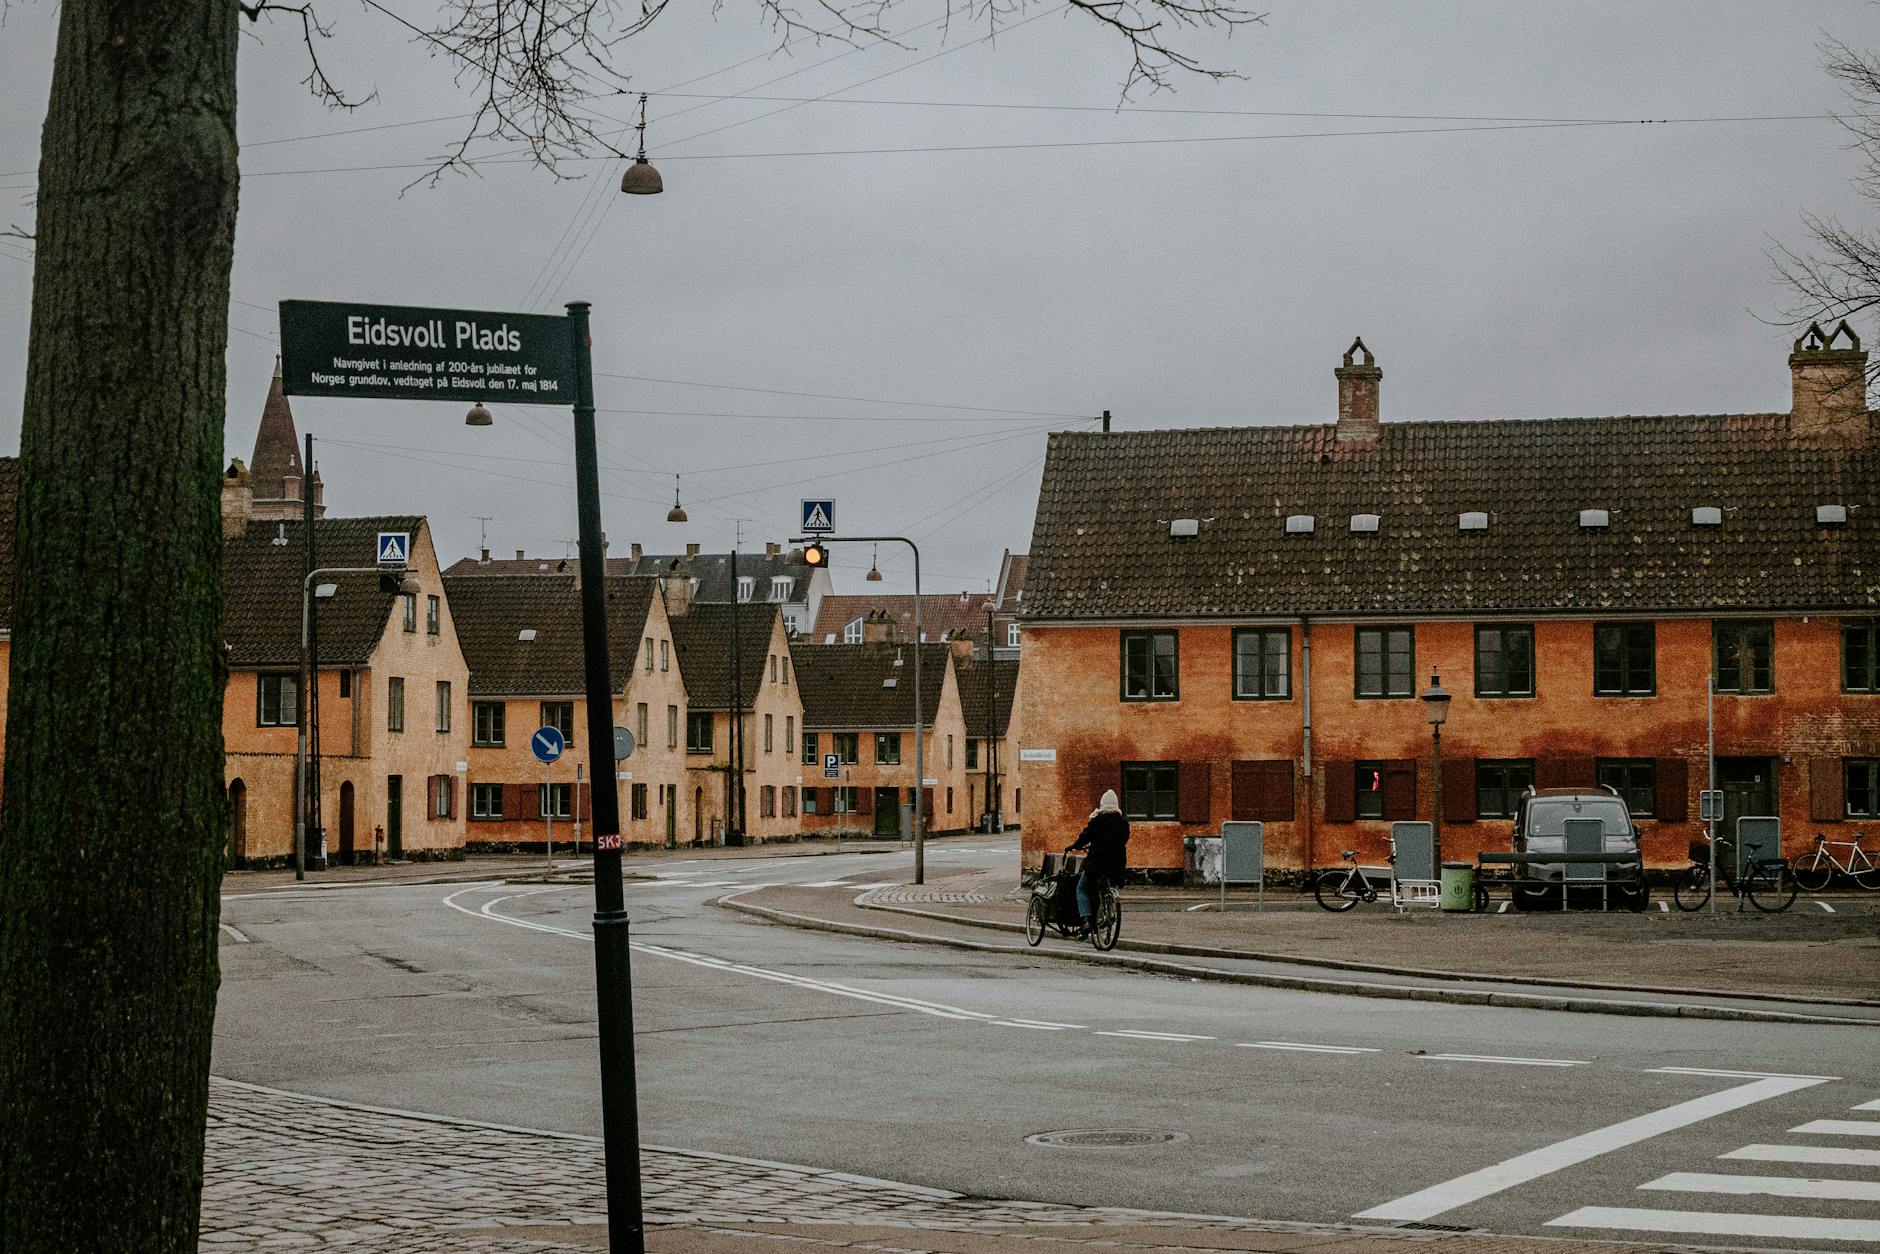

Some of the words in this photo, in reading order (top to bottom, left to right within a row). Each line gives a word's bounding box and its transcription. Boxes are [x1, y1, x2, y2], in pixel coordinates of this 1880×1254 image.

[347, 315, 447, 349] Eidsvoll
[455, 321, 522, 352] Plads
[333, 357, 380, 372] Navngivet
[382, 359, 387, 370] i
[389, 360, 433, 374] anledning
[435, 361, 445, 372] af
[448, 361, 485, 373] 200-års
[486, 363, 522, 375] jubilæet
[524, 364, 538, 375] for
[311, 372, 346, 386] Norges
[348, 374, 391, 387] grundlov,
[393, 375, 434, 388] vedtaget
[436, 376, 449, 389] på
[451, 377, 486, 389] Eidsvoll
[488, 379, 505, 390] den
[507, 379, 519, 390] 17.
[521, 380, 537, 392] maj
[539, 380, 559, 391] 1814
[826, 755, 836, 768] P
